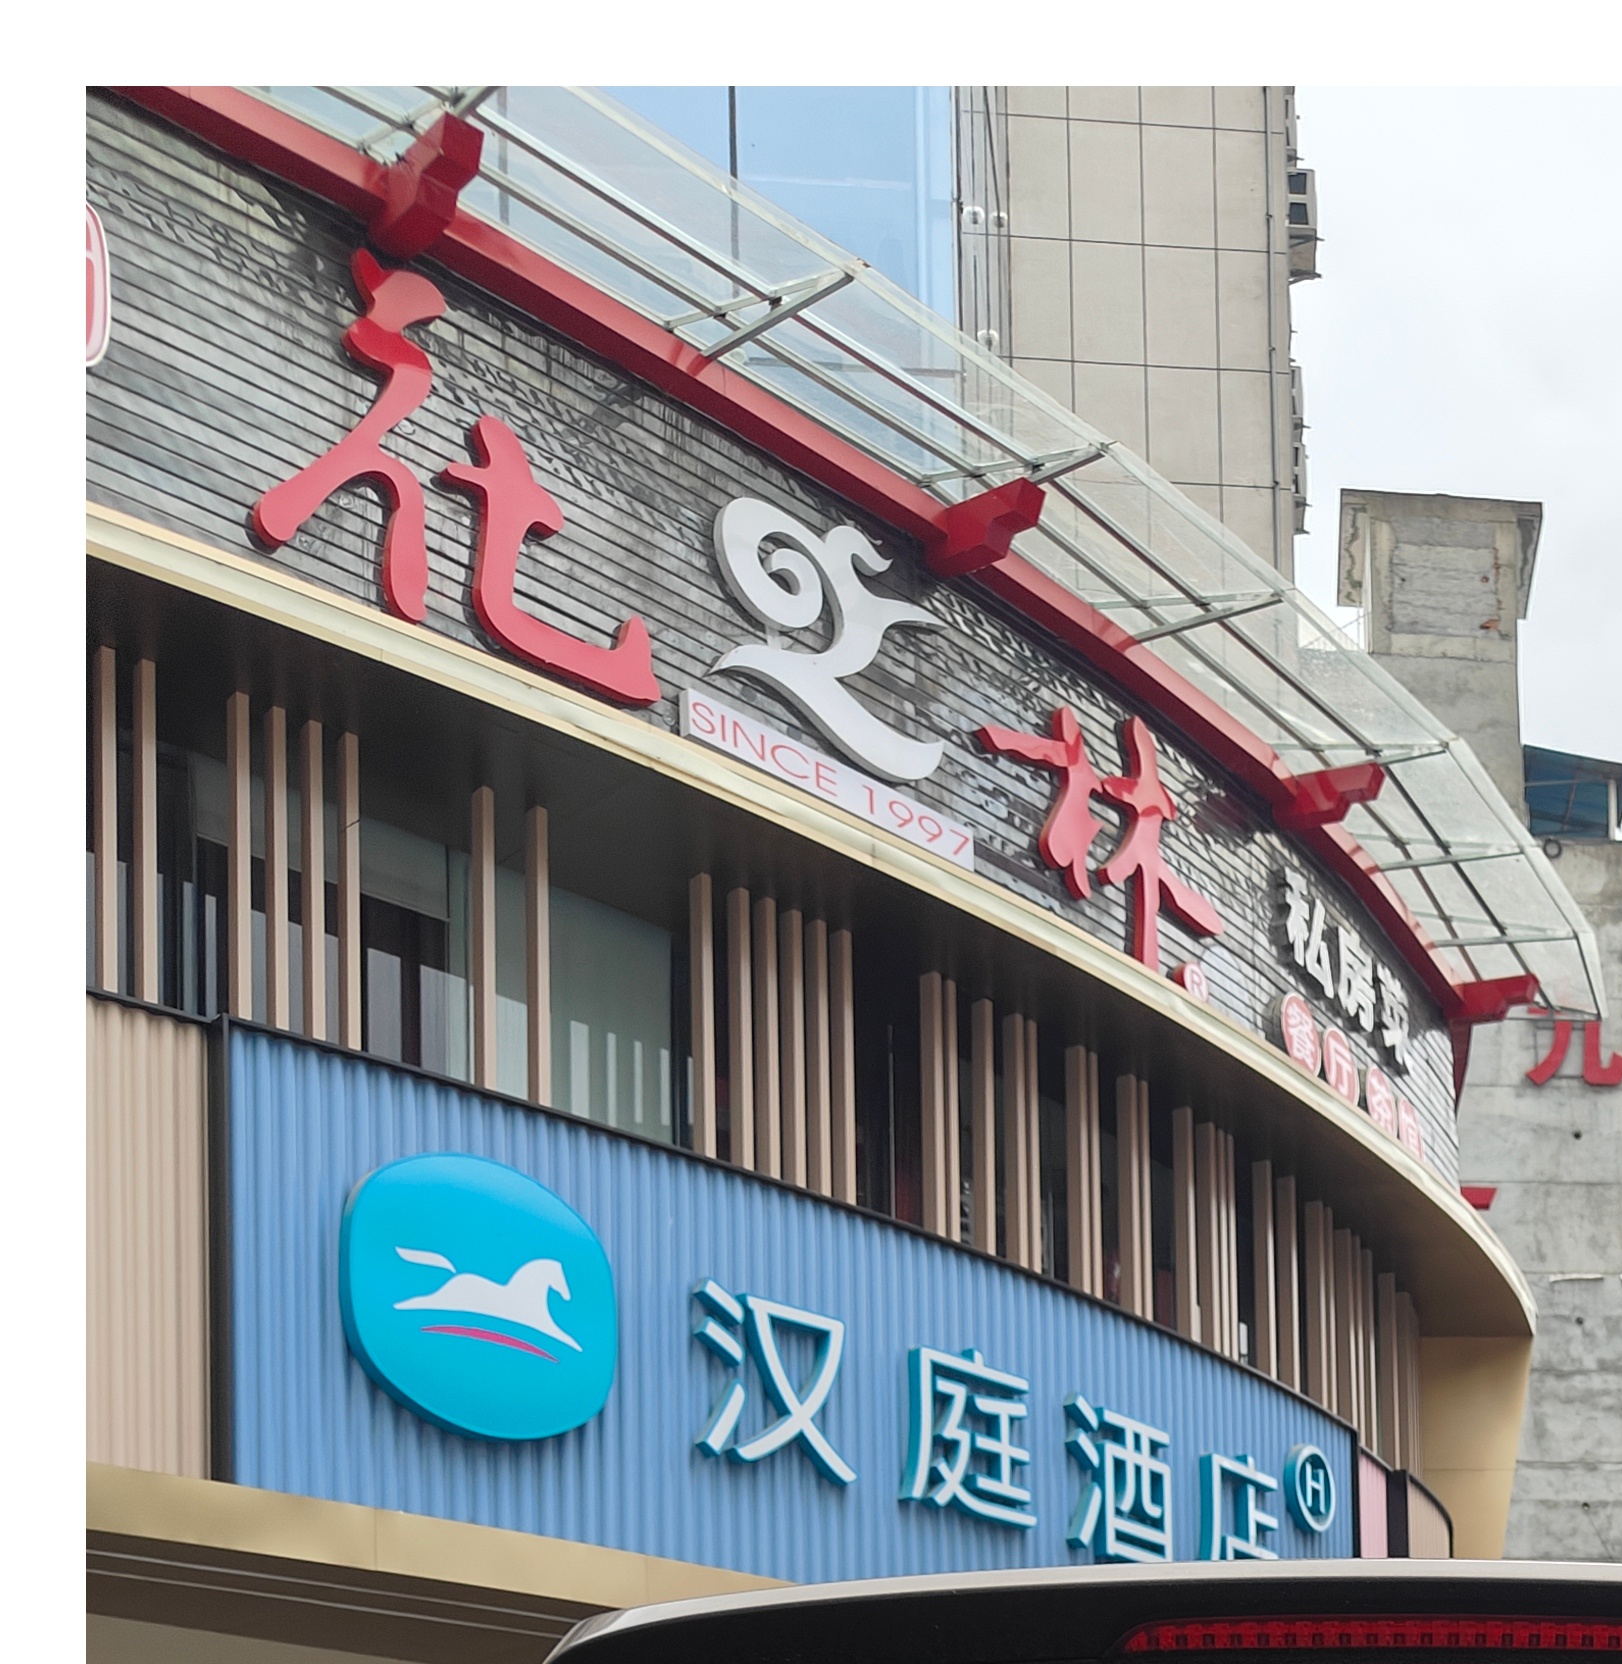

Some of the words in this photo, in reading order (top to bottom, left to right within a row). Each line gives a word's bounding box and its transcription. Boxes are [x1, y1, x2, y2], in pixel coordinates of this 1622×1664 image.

[691, 701, 838, 798] SINCE
[861, 783, 971, 857] 1997
[1284, 865, 1409, 1066] 私房菜
[692, 1278, 1279, 1561] 汉庭酒店
